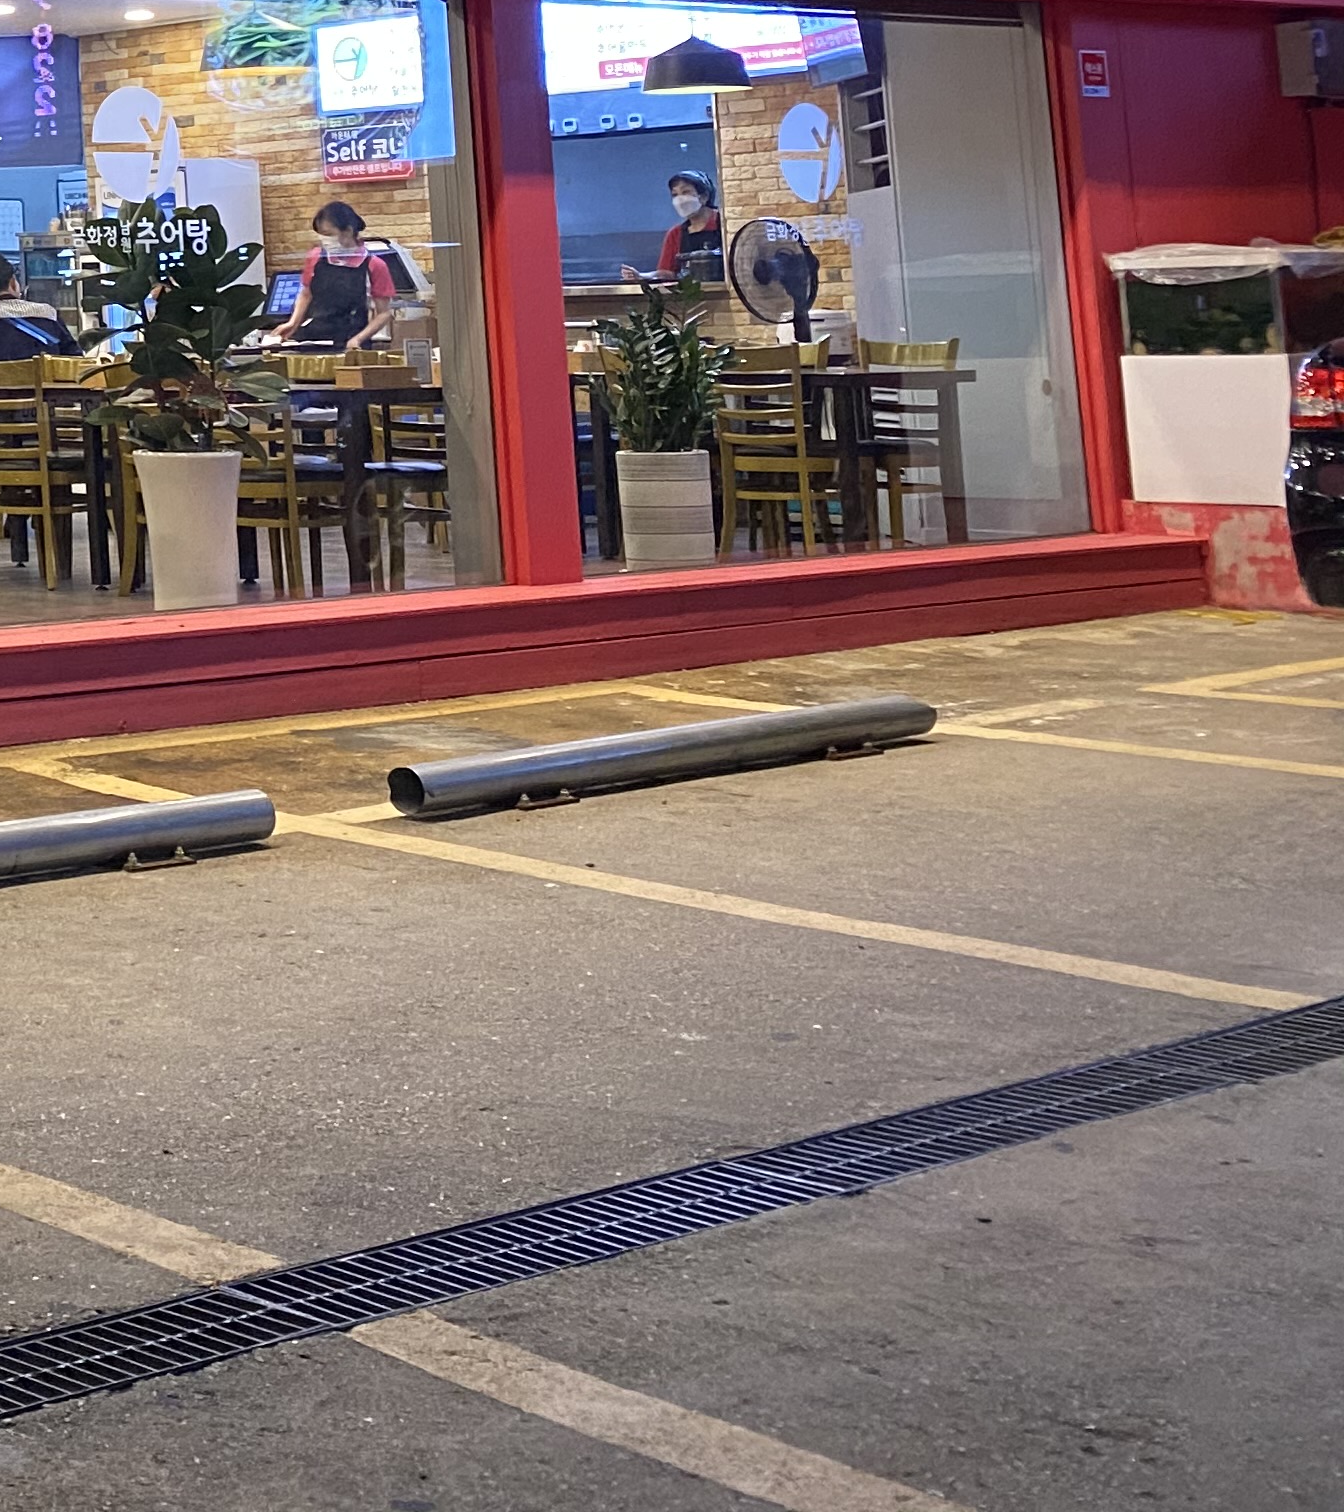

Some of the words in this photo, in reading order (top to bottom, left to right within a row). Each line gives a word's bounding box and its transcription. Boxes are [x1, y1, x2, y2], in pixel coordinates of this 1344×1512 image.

[326, 138, 368, 163] Self
[71, 224, 118, 248] 금화정
[135, 216, 212, 256] 추어탕
